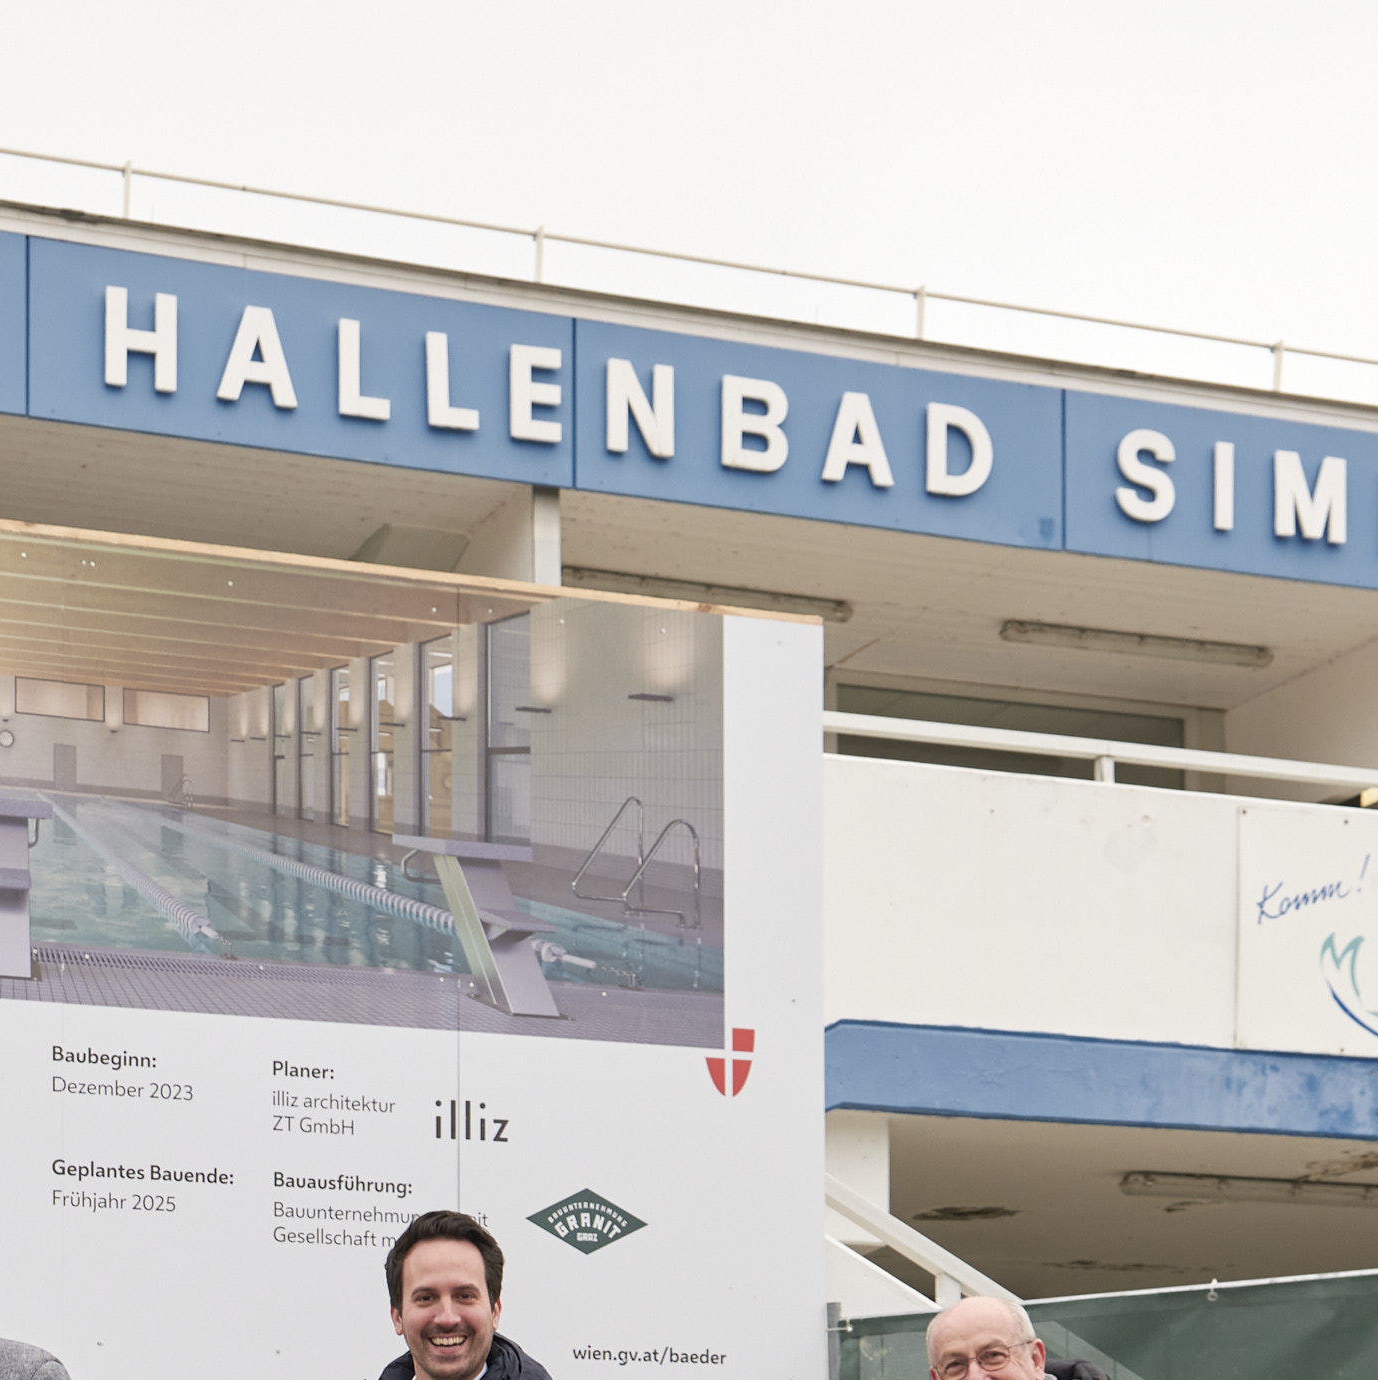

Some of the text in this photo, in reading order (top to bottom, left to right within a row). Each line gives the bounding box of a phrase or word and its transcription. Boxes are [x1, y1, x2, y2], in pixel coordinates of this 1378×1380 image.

[105, 285, 994, 498] HALLENBAD
[53, 1046, 156, 1070] Baubeginn:
[273, 1061, 334, 1079] Planer:
[53, 1076, 193, 1101] Dezember 2023
[273, 1090, 395, 1112] illiz architektur
[273, 1115, 354, 1135] ZT GmbH
[436, 1100, 509, 1142] illiz
[52, 1159, 233, 1184] Geplantes Bauende:
[274, 1172, 412, 1198] Bauausführung:
[53, 1190, 175, 1212] Frühjahr 2025
[547, 1202, 628, 1228] BAUUNTERNEHMUNG
[554, 1212, 621, 1239] GRANIT
[274, 1226, 376, 1246] Gesellschaft
[577, 1232, 598, 1242] GRAZ
[573, 1345, 726, 1366] wien.gv.at/baeder
